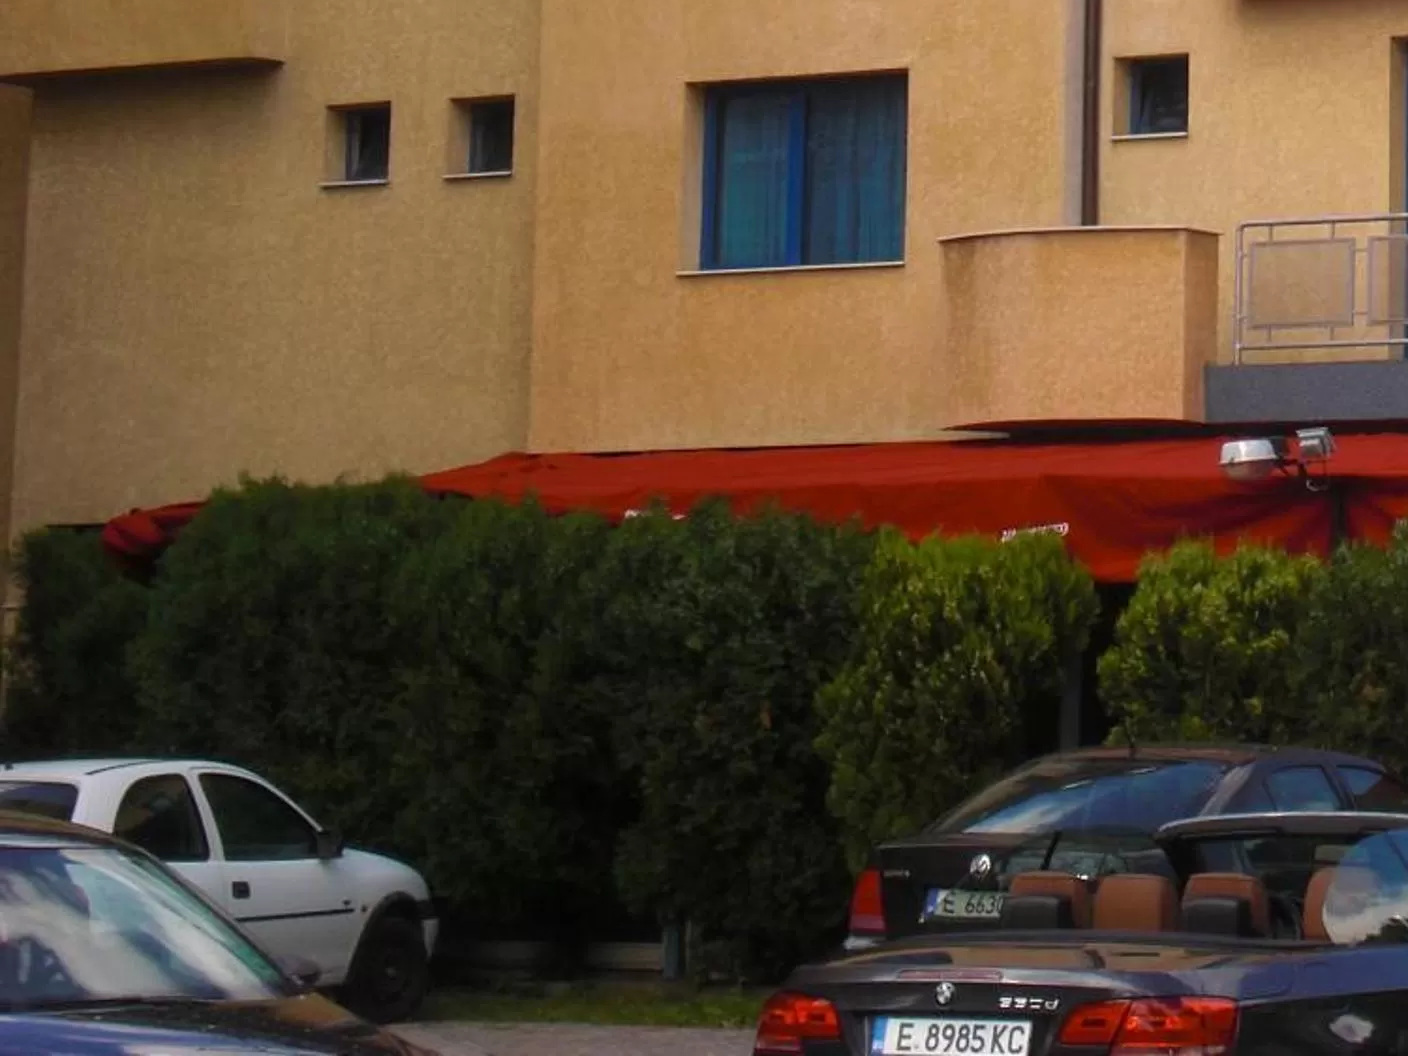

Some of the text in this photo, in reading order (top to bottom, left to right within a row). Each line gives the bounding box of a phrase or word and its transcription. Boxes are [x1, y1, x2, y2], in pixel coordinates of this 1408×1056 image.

[896, 1022, 1026, 1055] E 8985 KC
